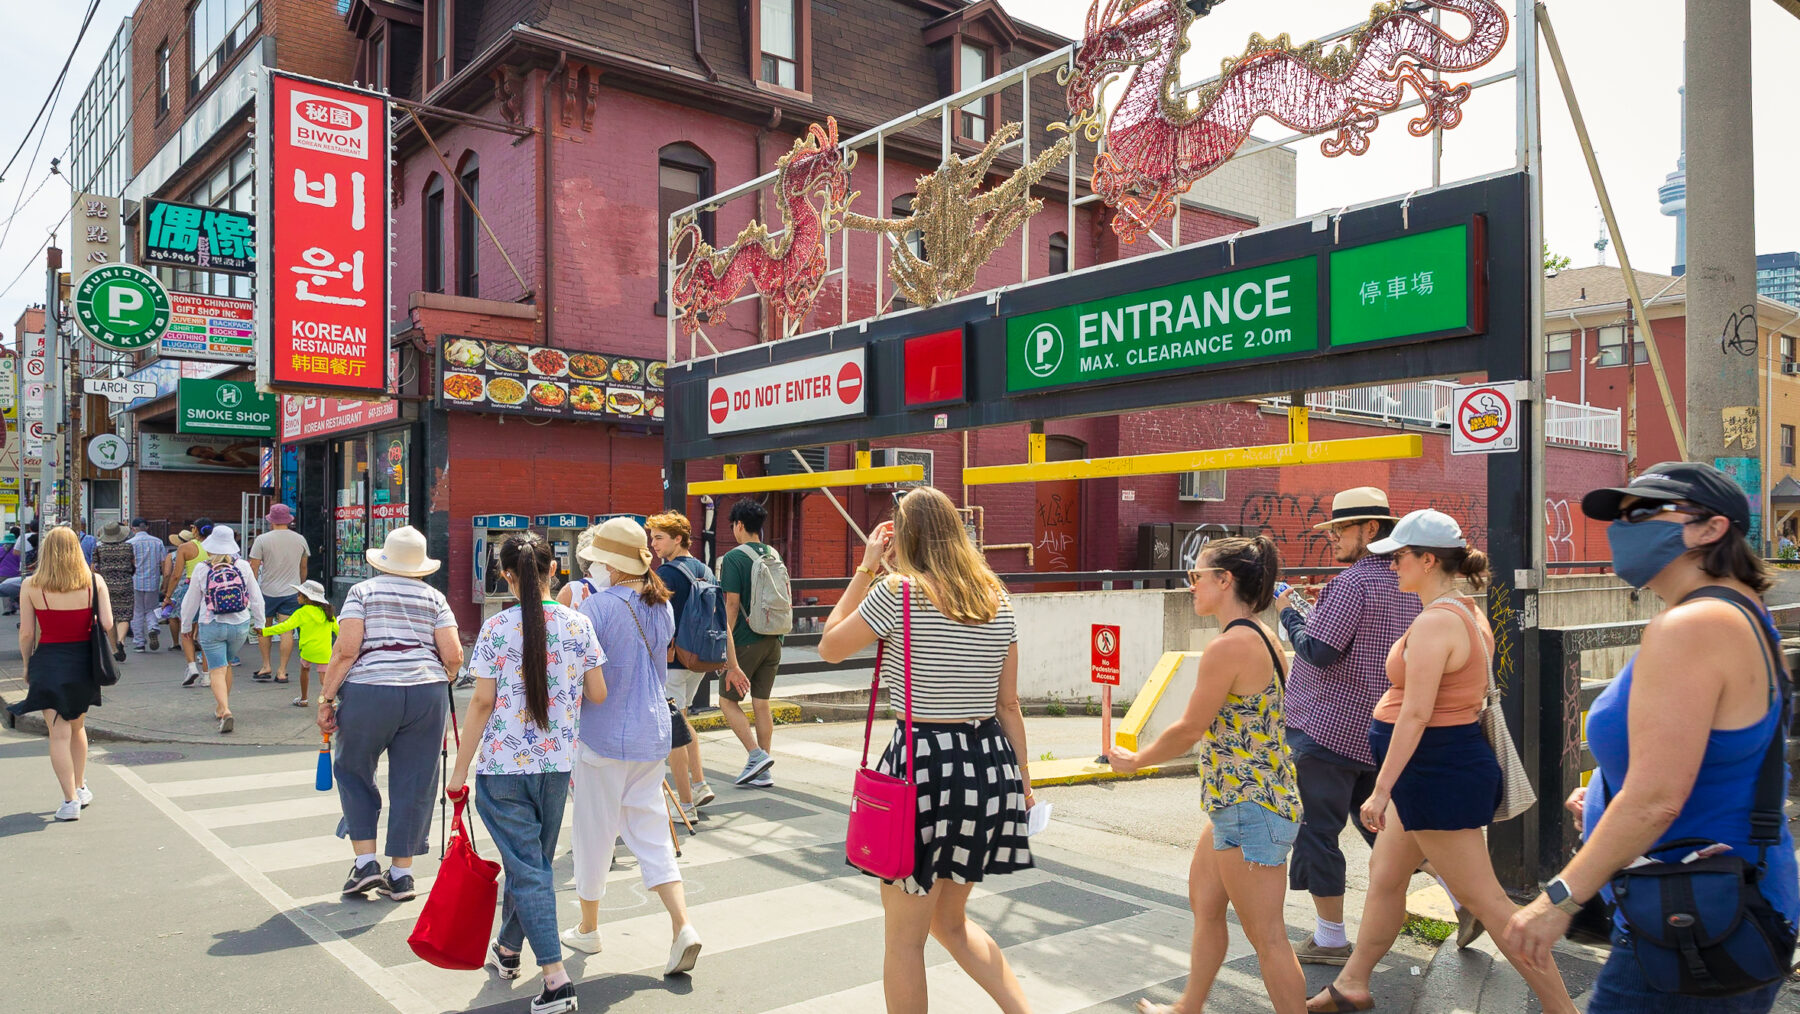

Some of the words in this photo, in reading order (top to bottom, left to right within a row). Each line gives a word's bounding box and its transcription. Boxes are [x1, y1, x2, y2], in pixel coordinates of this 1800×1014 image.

[297, 127, 361, 149] BIWON
[297, 139, 322, 148] KOREAN
[323, 143, 361, 155] RESTAURANT
[148, 202, 256, 260] 偶像
[82, 269, 163, 303] MUNICIPAL
[108, 286, 144, 318] P
[203, 298, 252, 310] CHINATOWN
[176, 305, 196, 314] GIFT
[197, 308, 220, 316] SHOP
[221, 311, 239, 319] INC.
[1079, 275, 1291, 348] ENTRANCE
[81, 310, 165, 346] PARKING
[212, 319, 252, 329] BACKPACK
[212, 327, 238, 336] SOCKS
[291, 319, 367, 344] KOREAN
[166, 332, 205, 341] CLOTHING
[166, 341, 203, 350] LUGGAGE
[291, 338, 367, 357] RESTAURANT
[1036, 330, 1054, 364] P
[1080, 352, 1119, 373] MAX.
[1126, 333, 1234, 366] CLEARANCE
[1244, 327, 1292, 348] 2.0m
[291, 354, 367, 377] 韩国餐厅
[93, 381, 128, 394] LARCH
[133, 384, 147, 396] ST.
[733, 389, 751, 412] DO
[755, 383, 781, 408] NOT
[785, 374, 831, 403] ENTER
[187, 408, 233, 421] SMOKE
[236, 411, 270, 423] SHOP
[303, 419, 325, 435] KOREAN
[326, 411, 363, 430] RESTAURANT
[499, 516, 517, 527] Bell
[559, 516, 577, 527] Bell
[1092, 664, 1120, 674] Pedestrian
[1096, 672, 1116, 681] Access
